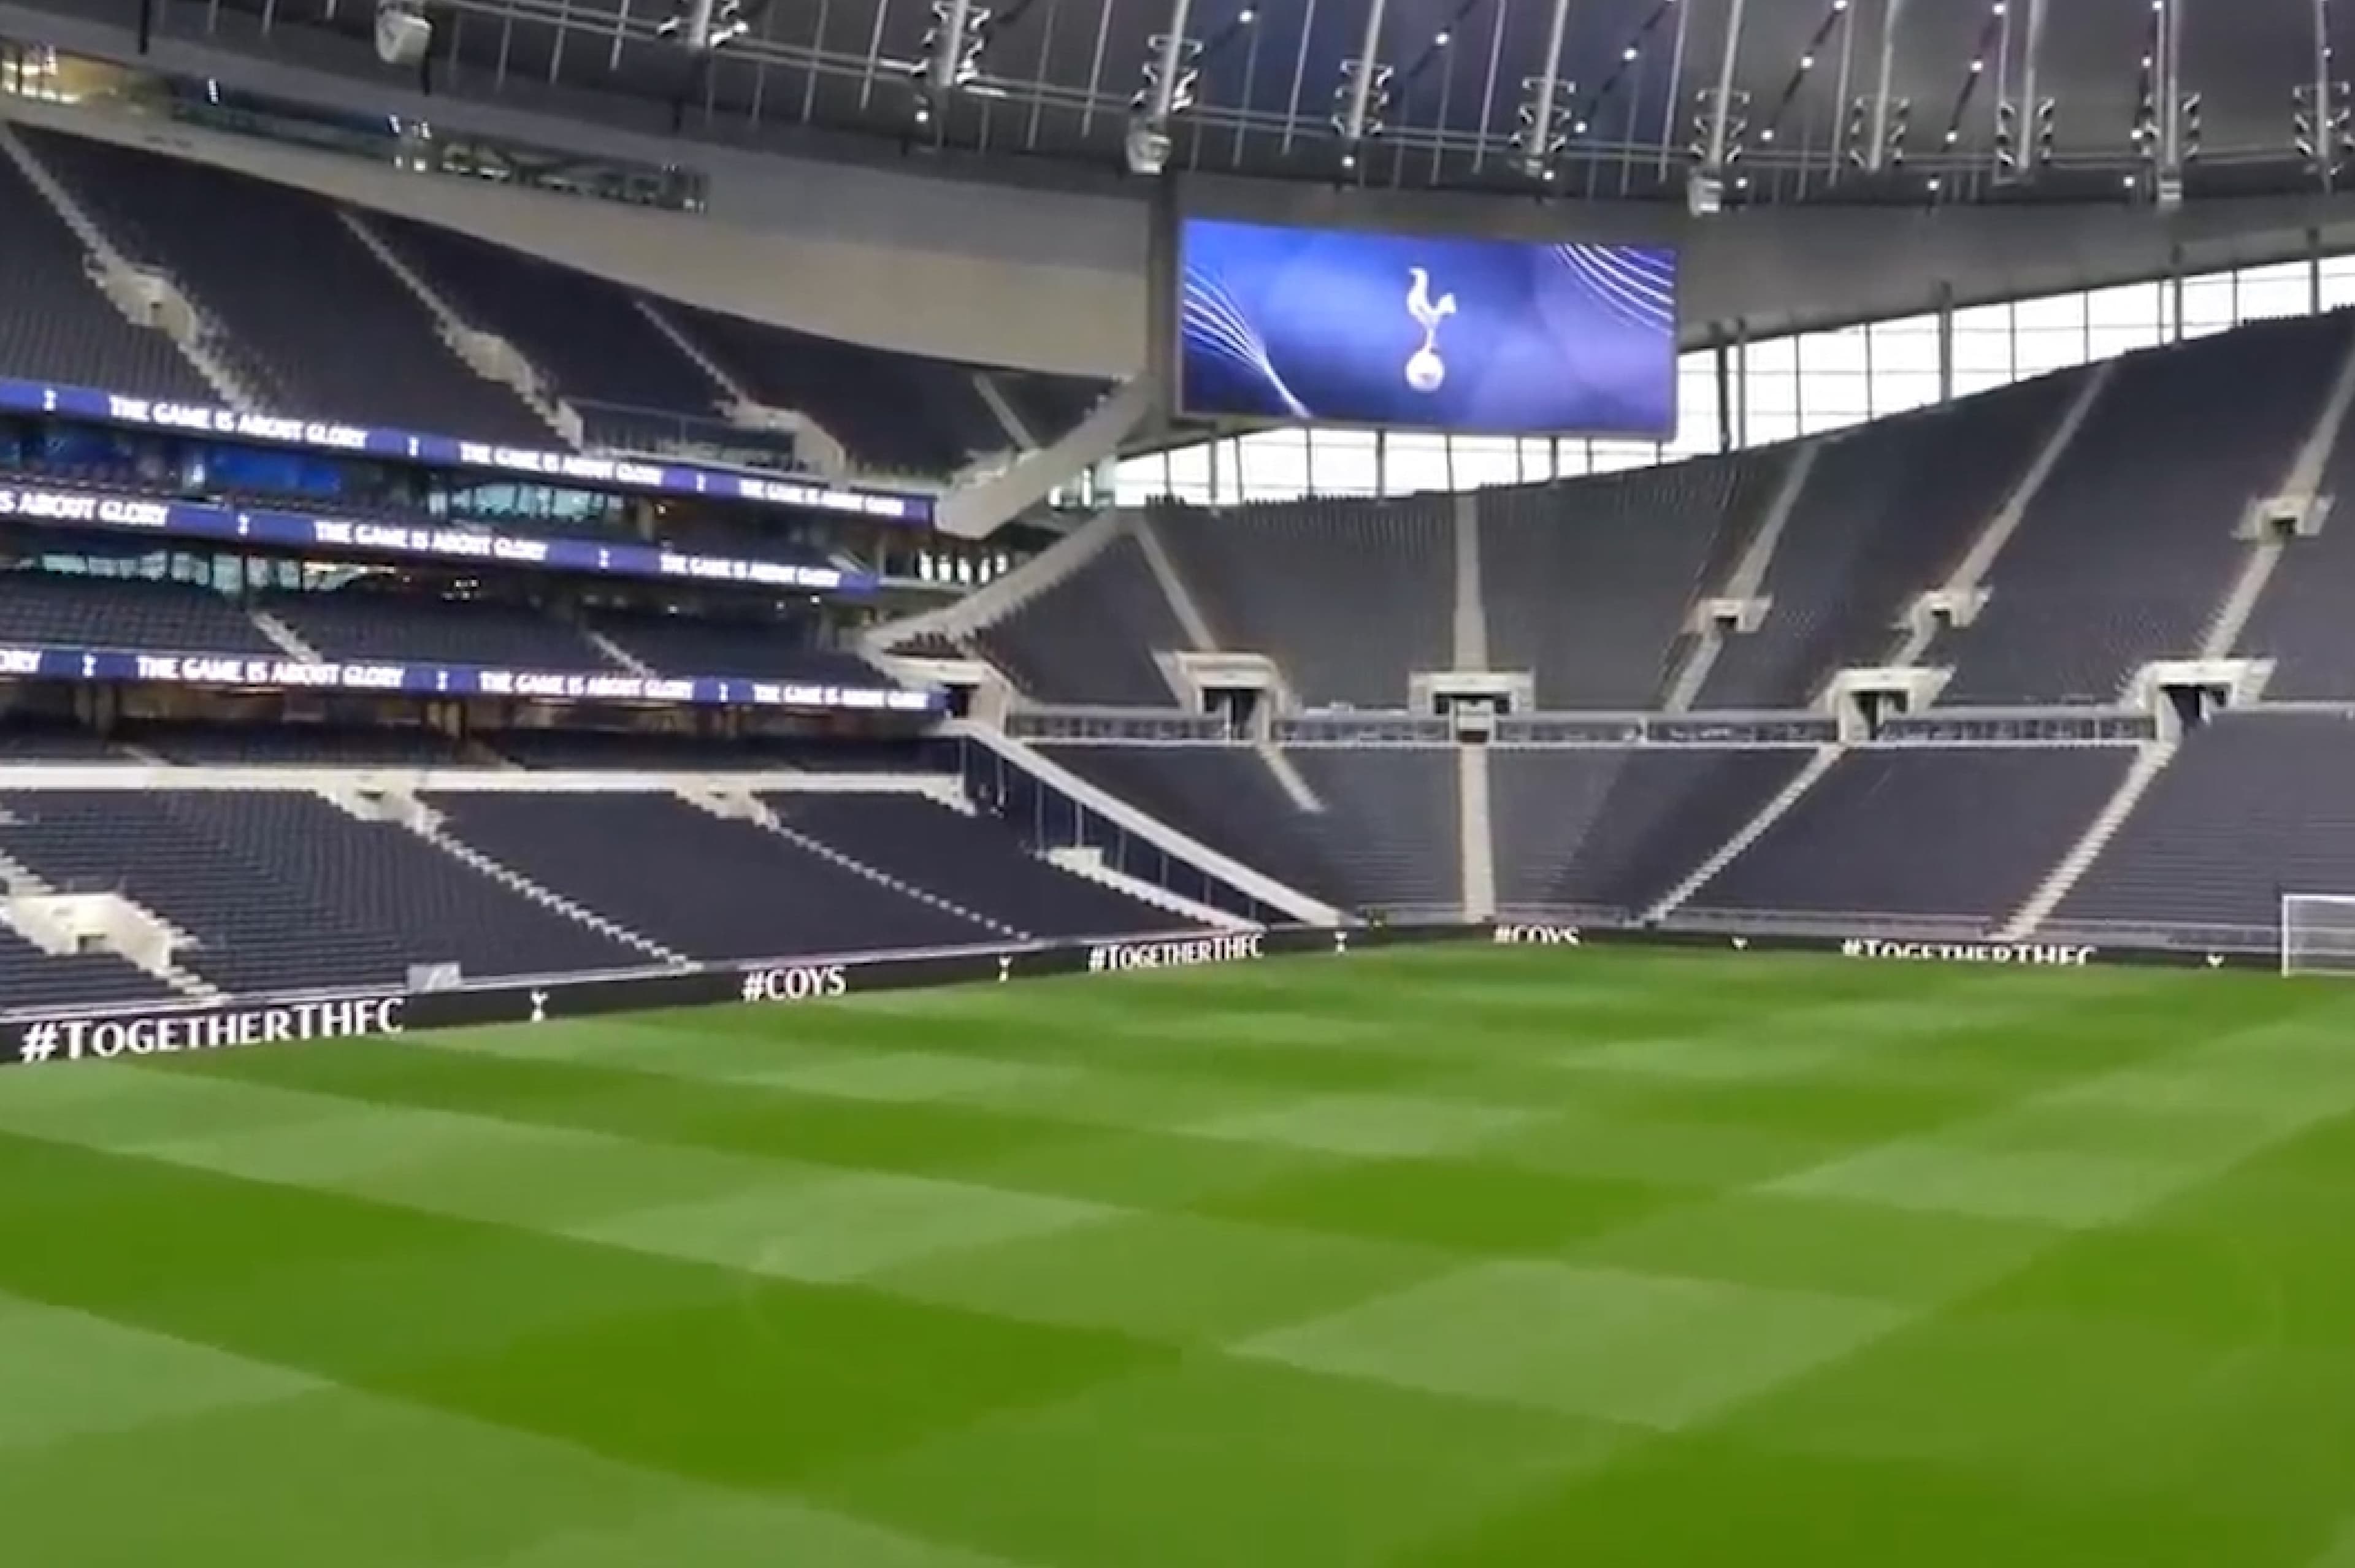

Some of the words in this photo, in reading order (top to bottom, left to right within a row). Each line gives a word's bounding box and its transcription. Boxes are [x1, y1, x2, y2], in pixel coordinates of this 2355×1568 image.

[109, 395, 149, 422] THE
[153, 402, 209, 429] GAME
[215, 411, 234, 431] IS
[237, 413, 304, 441] ABOUT
[306, 422, 368, 449] GLORY
[461, 442, 491, 464] THE
[0, 491, 15, 513] S
[18, 491, 96, 520] ABOUT
[99, 499, 167, 526] GLORY
[315, 521, 353, 545] THE
[356, 523, 408, 549] GAME
[411, 530, 429, 551] IS
[432, 529, 492, 556] ABOUT
[493, 537, 547, 560] GLORY
[0, 649, 41, 673] ORY
[137, 657, 181, 679] THE
[182, 657, 245, 682] GAME
[247, 661, 267, 683] IS
[270, 661, 340, 686] ABOUT
[342, 664, 405, 688] GLORY
[480, 671, 512, 692] THE
[516, 673, 564, 695] GAME
[587, 676, 641, 697] ABOUT
[644, 678, 695, 700] GLORY
[1089, 933, 1265, 973] #TOGETHERTHFC
[741, 966, 846, 1001] #COYS
[21, 998, 405, 1062] #TOGETHERTHFC
